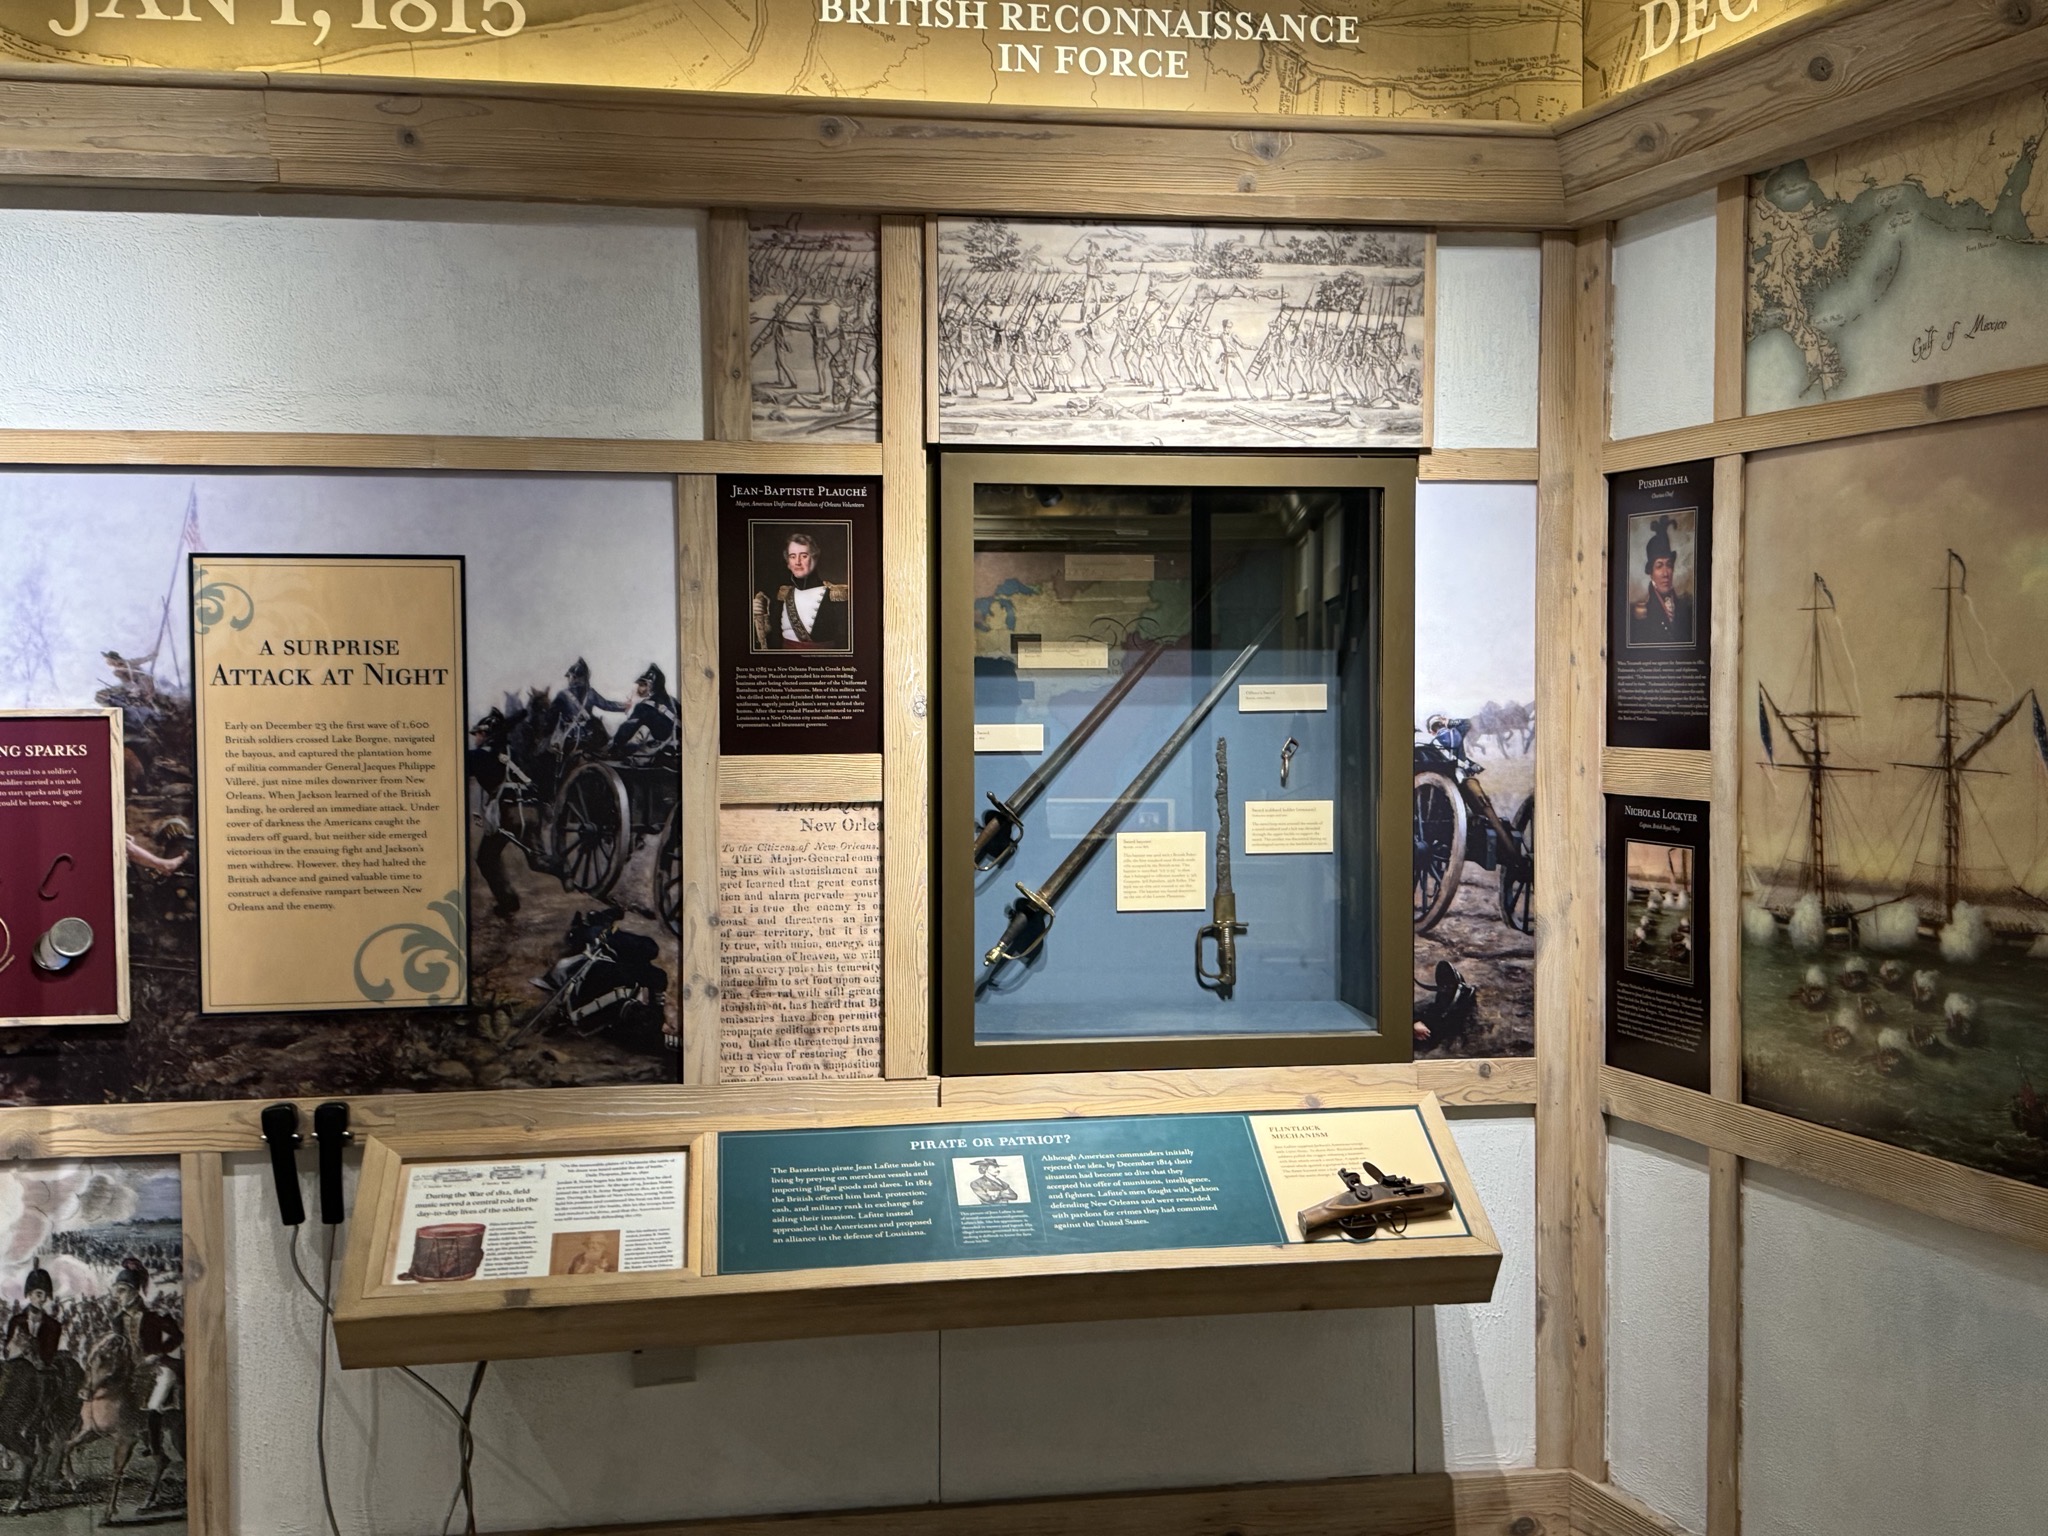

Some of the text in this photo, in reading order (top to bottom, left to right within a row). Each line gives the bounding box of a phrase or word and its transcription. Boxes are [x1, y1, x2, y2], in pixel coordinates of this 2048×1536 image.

[819, 0, 1360, 44] BRITISH RECONNAISSANCE
[998, 43, 1189, 79] IN FORCE
[1912, 313, 2007, 363] Gulf of Mexico
[1638, 475, 1689, 490] PUSHMATAHA
[730, 484, 868, 498] JEAN-BAPTISTE PLAUCHÉ
[258, 639, 400, 656] A SURPRISE
[210, 662, 448, 686] ATTACK AT NIGHT
[225, 721, 248, 732] Early
[265, 721, 312, 730] December
[315, 723, 327, 731] 23
[329, 721, 343, 729] the
[346, 721, 365, 729] first
[390, 720, 401, 729] of
[225, 735, 256, 744] British
[258, 735, 294, 744] soldiers
[295, 735, 329, 743] crossed
[332, 735, 353, 743] Lake
[394, 734, 435, 745] navigated
[25, 744, 88, 757] SPARKS
[225, 749, 240, 758] the
[278, 749, 296, 757] and
[298, 749, 338, 759] captured
[340, 748, 355, 757] the
[357, 748, 404, 759] plantation
[406, 748, 432, 757] home
[225, 761, 436, 773] of militia commander General Jacques Philippe
[261, 779, 278, 788] just
[305, 777, 329, 785] miles
[331, 776, 377, 784] downriver
[380, 776, 403, 784] from
[405, 776, 426, 784] New
[25, 789, 46, 798] sparks
[268, 791, 296, 799] When
[295, 791, 332, 801] Jackson
[334, 790, 369, 799] learned
[371, 789, 382, 798] of
[383, 789, 398, 798] the
[400, 789, 431, 798] British
[1624, 804, 1698, 822] NICHOLAS LOCKYER
[800, 817, 836, 832] New
[732, 855, 762, 864] THE
[720, 929, 732, 938] of
[764, 928, 813, 938] territory,
[819, 926, 836, 936] but
[844, 926, 852, 935] it
[860, 925, 868, 934] is
[720, 954, 782, 964] approbation
[786, 952, 797, 961] of
[910, 1134, 1071, 1150] PIRATE OR PATRIOT?
[1041, 1148, 1194, 1162] Although American commanders initially
[831, 1165, 854, 1173] pirate
[854, 1163, 872, 1172] Jean
[1043, 1163, 1072, 1172] rejected
[1106, 1161, 1116, 1169] by
